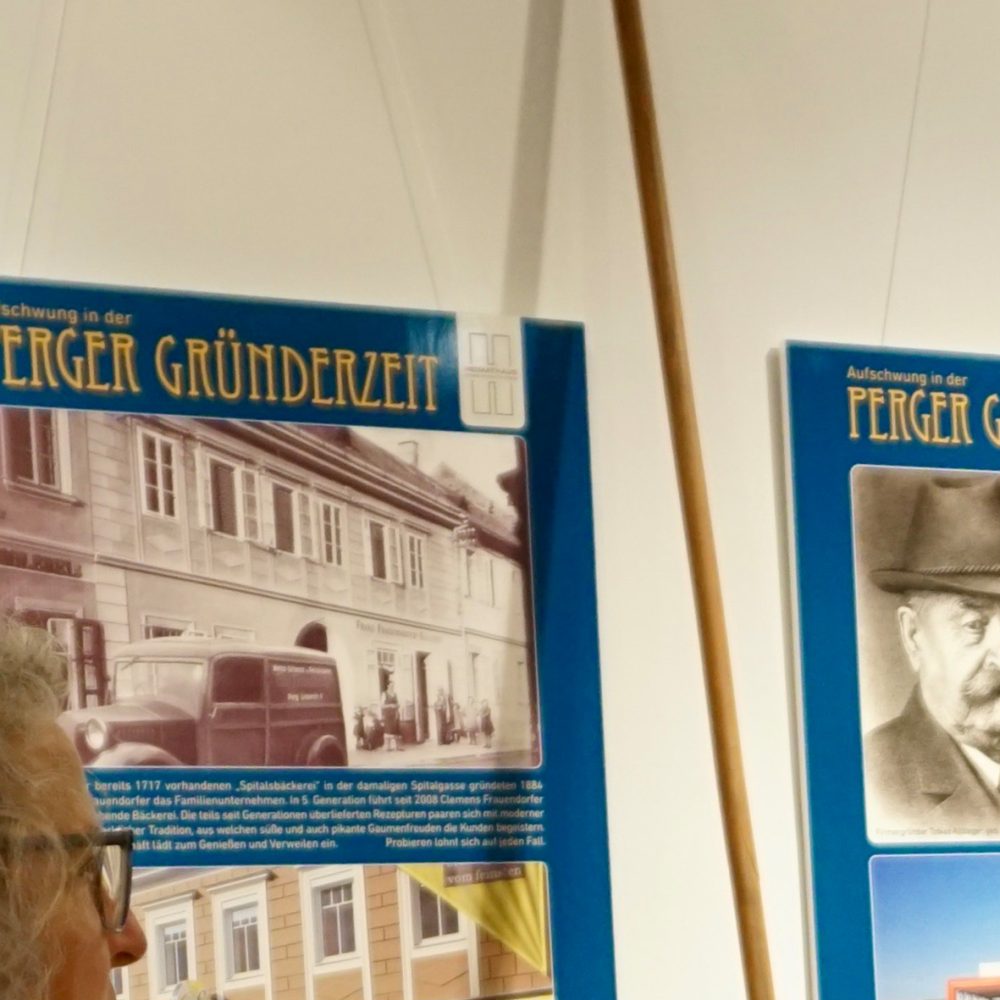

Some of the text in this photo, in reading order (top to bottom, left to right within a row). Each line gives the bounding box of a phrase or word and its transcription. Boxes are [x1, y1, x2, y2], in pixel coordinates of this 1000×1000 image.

[83, 308, 99, 322] in
[104, 310, 132, 324] der
[154, 327, 438, 412] GRÜNDERZEIT
[846, 366, 968, 387] Aufschwung in der
[847, 385, 973, 443] PERGER
[94, 780, 131, 791] bereits
[135, 780, 161, 791] 1717
[165, 780, 231, 791] vorhandenen
[324, 780, 333, 791] in
[336, 780, 353, 791] der
[356, 780, 408, 793] damaligen
[411, 781, 465, 793] Spitalgasse
[520, 781, 543, 791] 1884
[153, 795, 172, 806] das
[312, 795, 366, 805] Generation
[368, 795, 392, 805] führt
[394, 795, 412, 805] seit
[440, 795, 481, 805] Clemens
[174, 841, 197, 849] zum
[198, 839, 246, 849] Genießen
[248, 839, 268, 849] und
[269, 838, 319, 849] Verweilen
[385, 838, 432, 848] Probieren
[460, 837, 480, 847] sich
